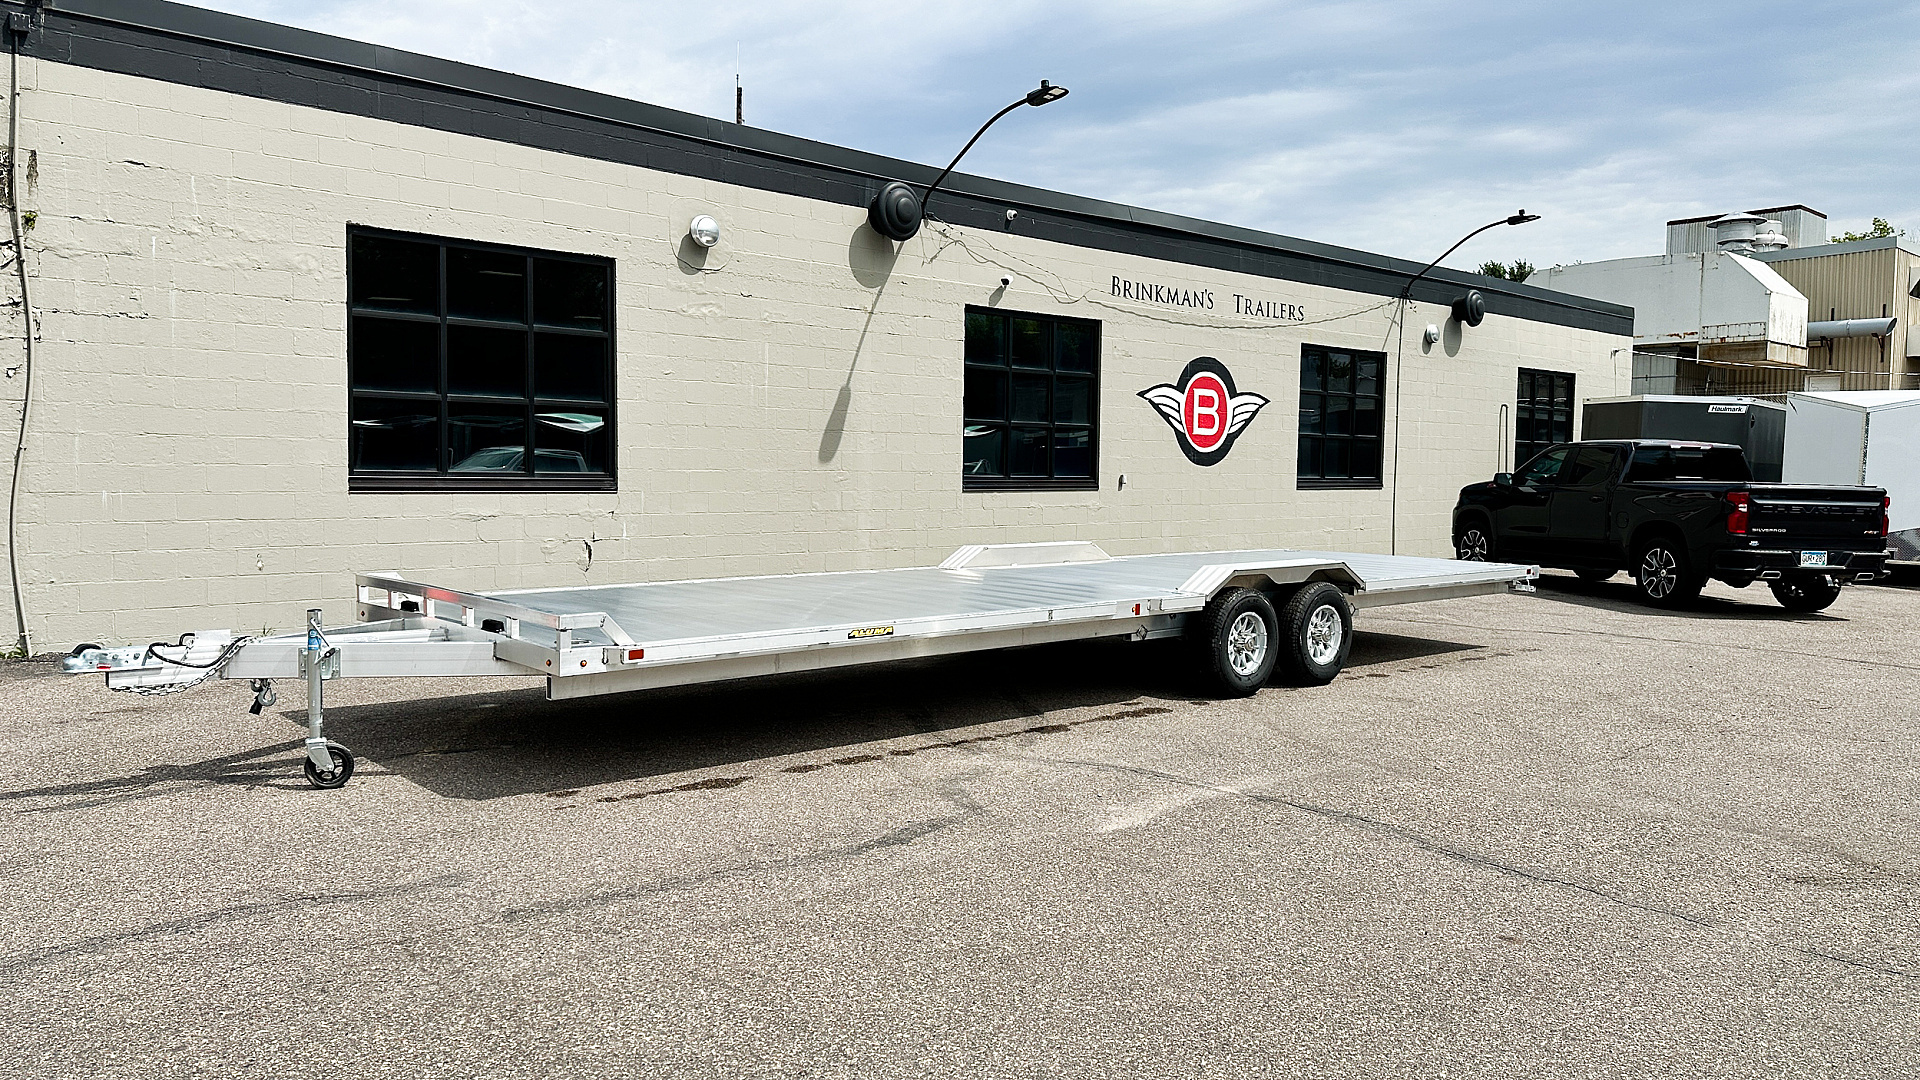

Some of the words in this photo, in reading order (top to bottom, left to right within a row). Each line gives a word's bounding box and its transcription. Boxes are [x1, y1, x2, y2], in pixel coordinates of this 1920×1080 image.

[1111, 275, 1214, 310] BRINKMAN'S
[1233, 293, 1305, 322] TRAILERS
[1192, 388, 1220, 436] B
[848, 626, 894, 639] ALUMA
